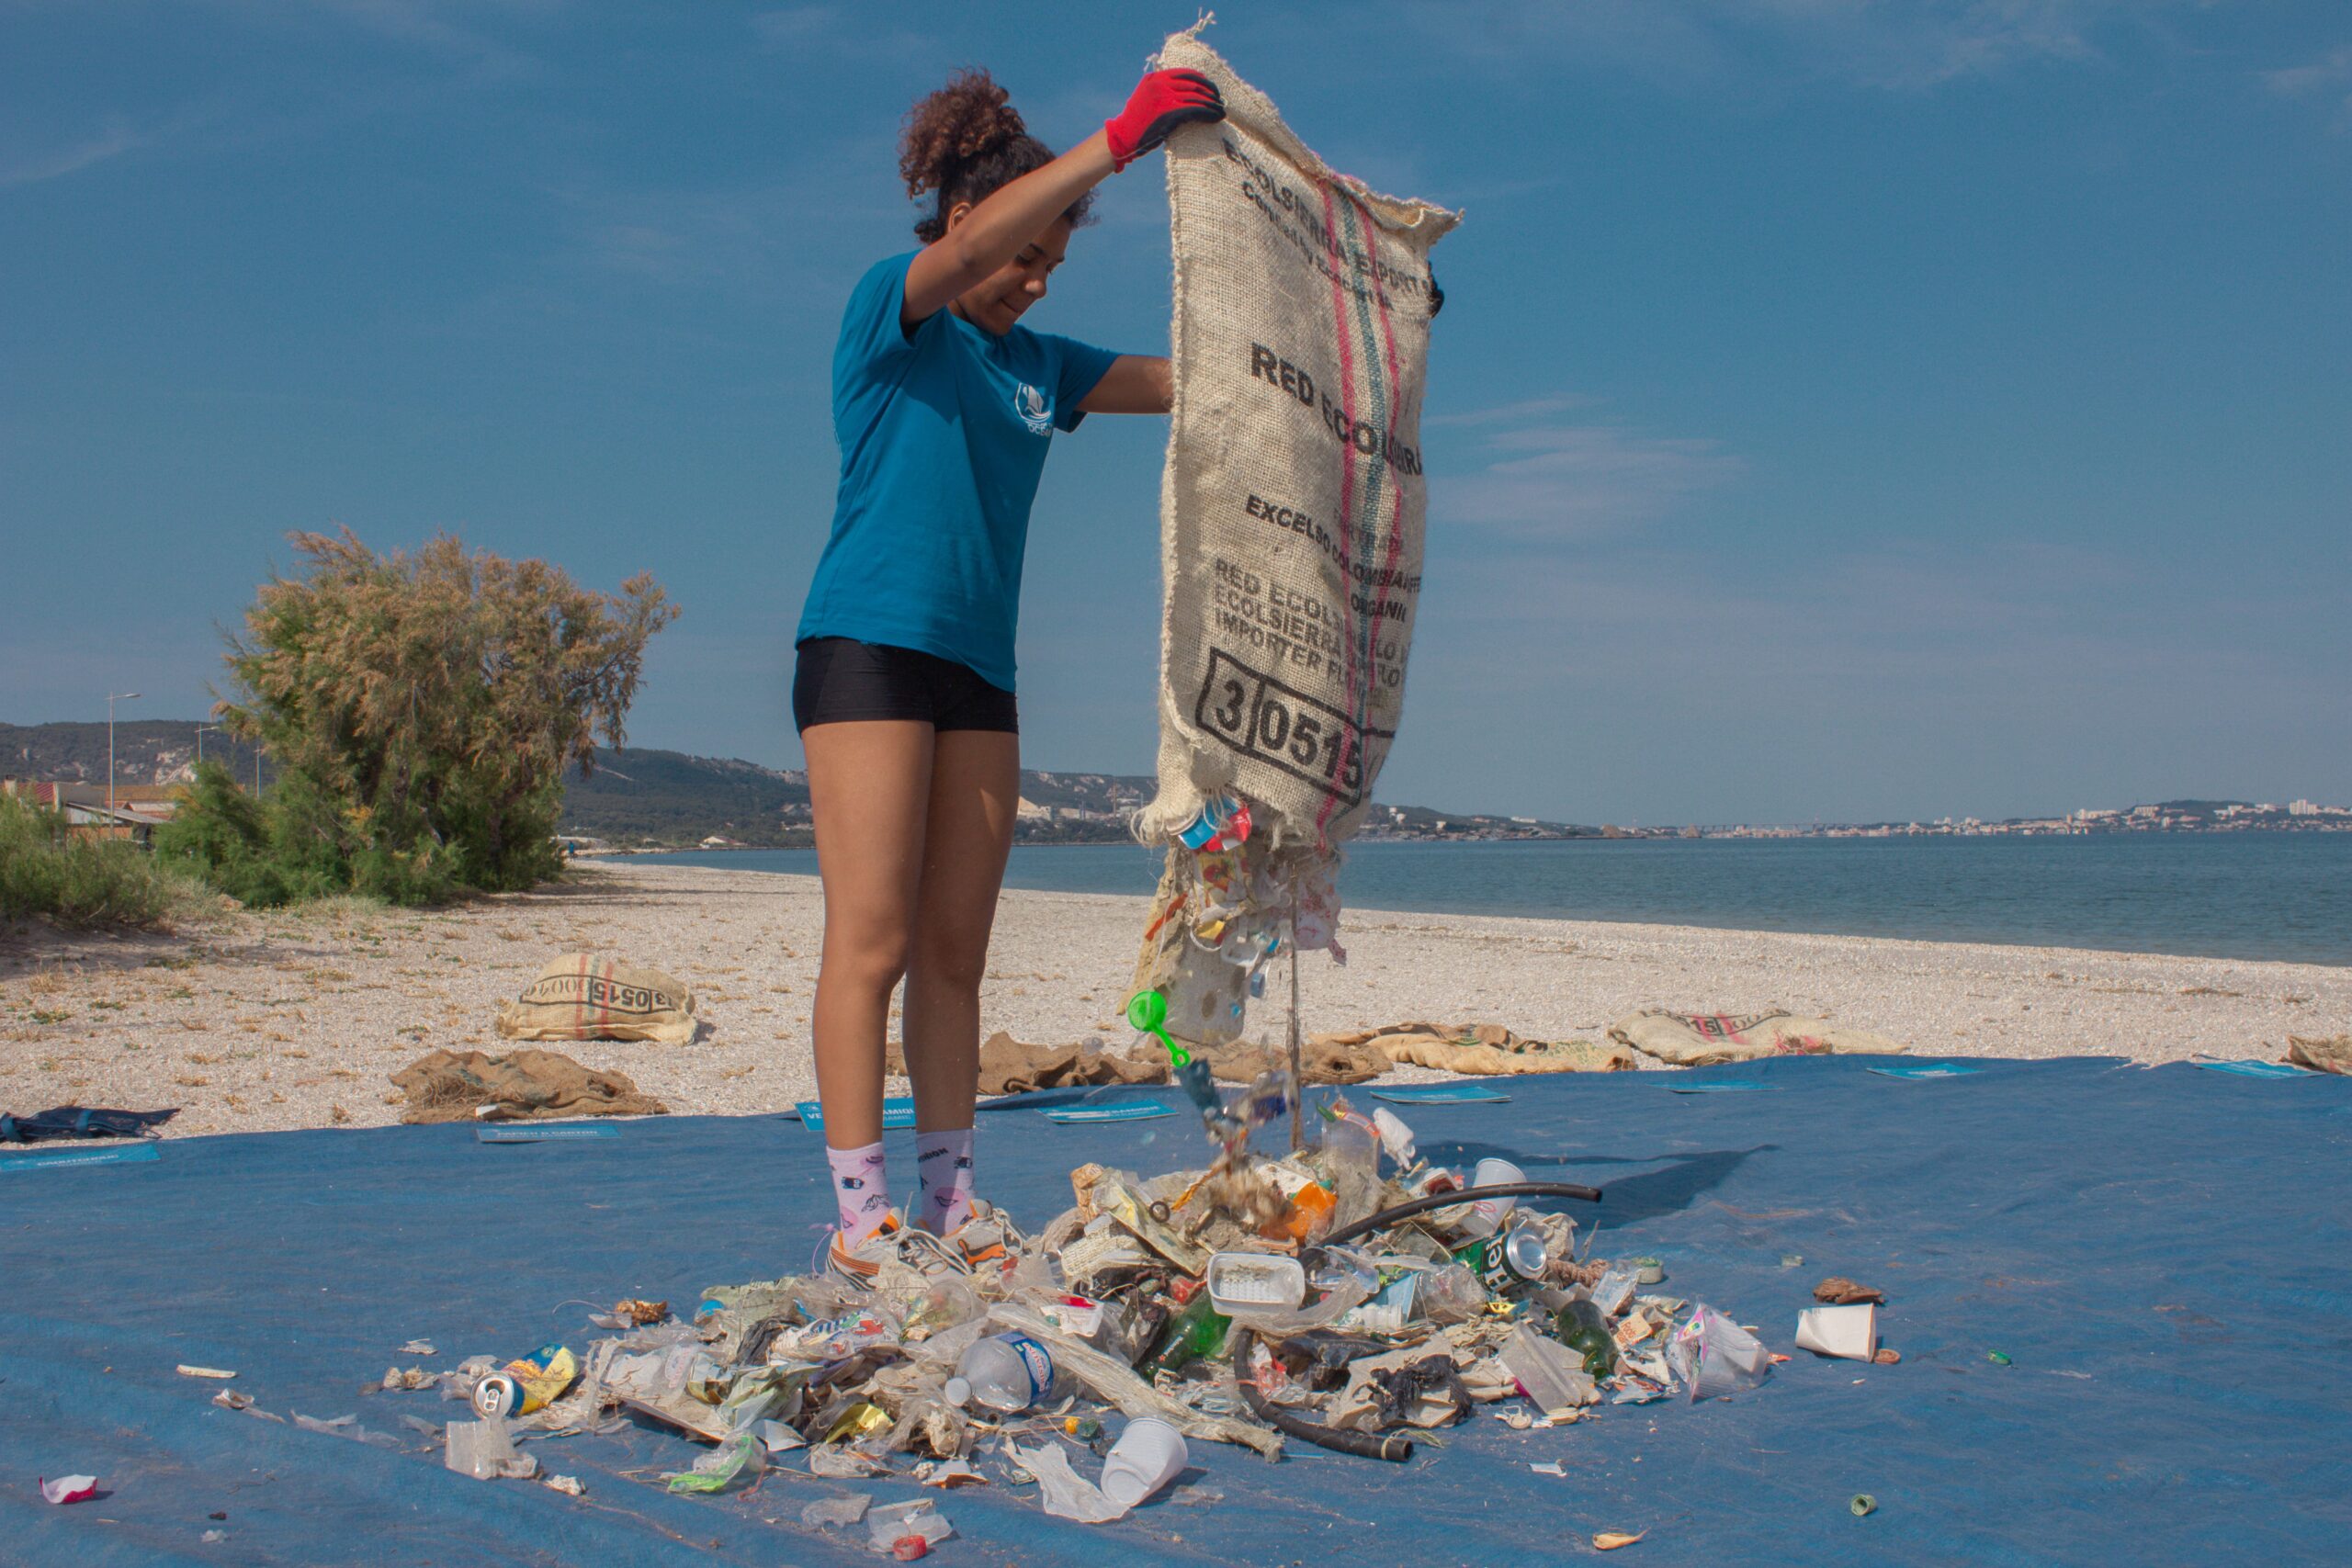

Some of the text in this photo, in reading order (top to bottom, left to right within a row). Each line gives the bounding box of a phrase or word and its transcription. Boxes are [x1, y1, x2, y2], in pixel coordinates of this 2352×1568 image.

[1250, 341, 1314, 407] RED
[1246, 494, 1330, 553] EXCELSO
[1216, 558, 1261, 595] RED
[1216, 607, 1323, 671] IMPORTER
[1217, 679, 1361, 789] 3 0515
[594, 982, 649, 1008] 0515
